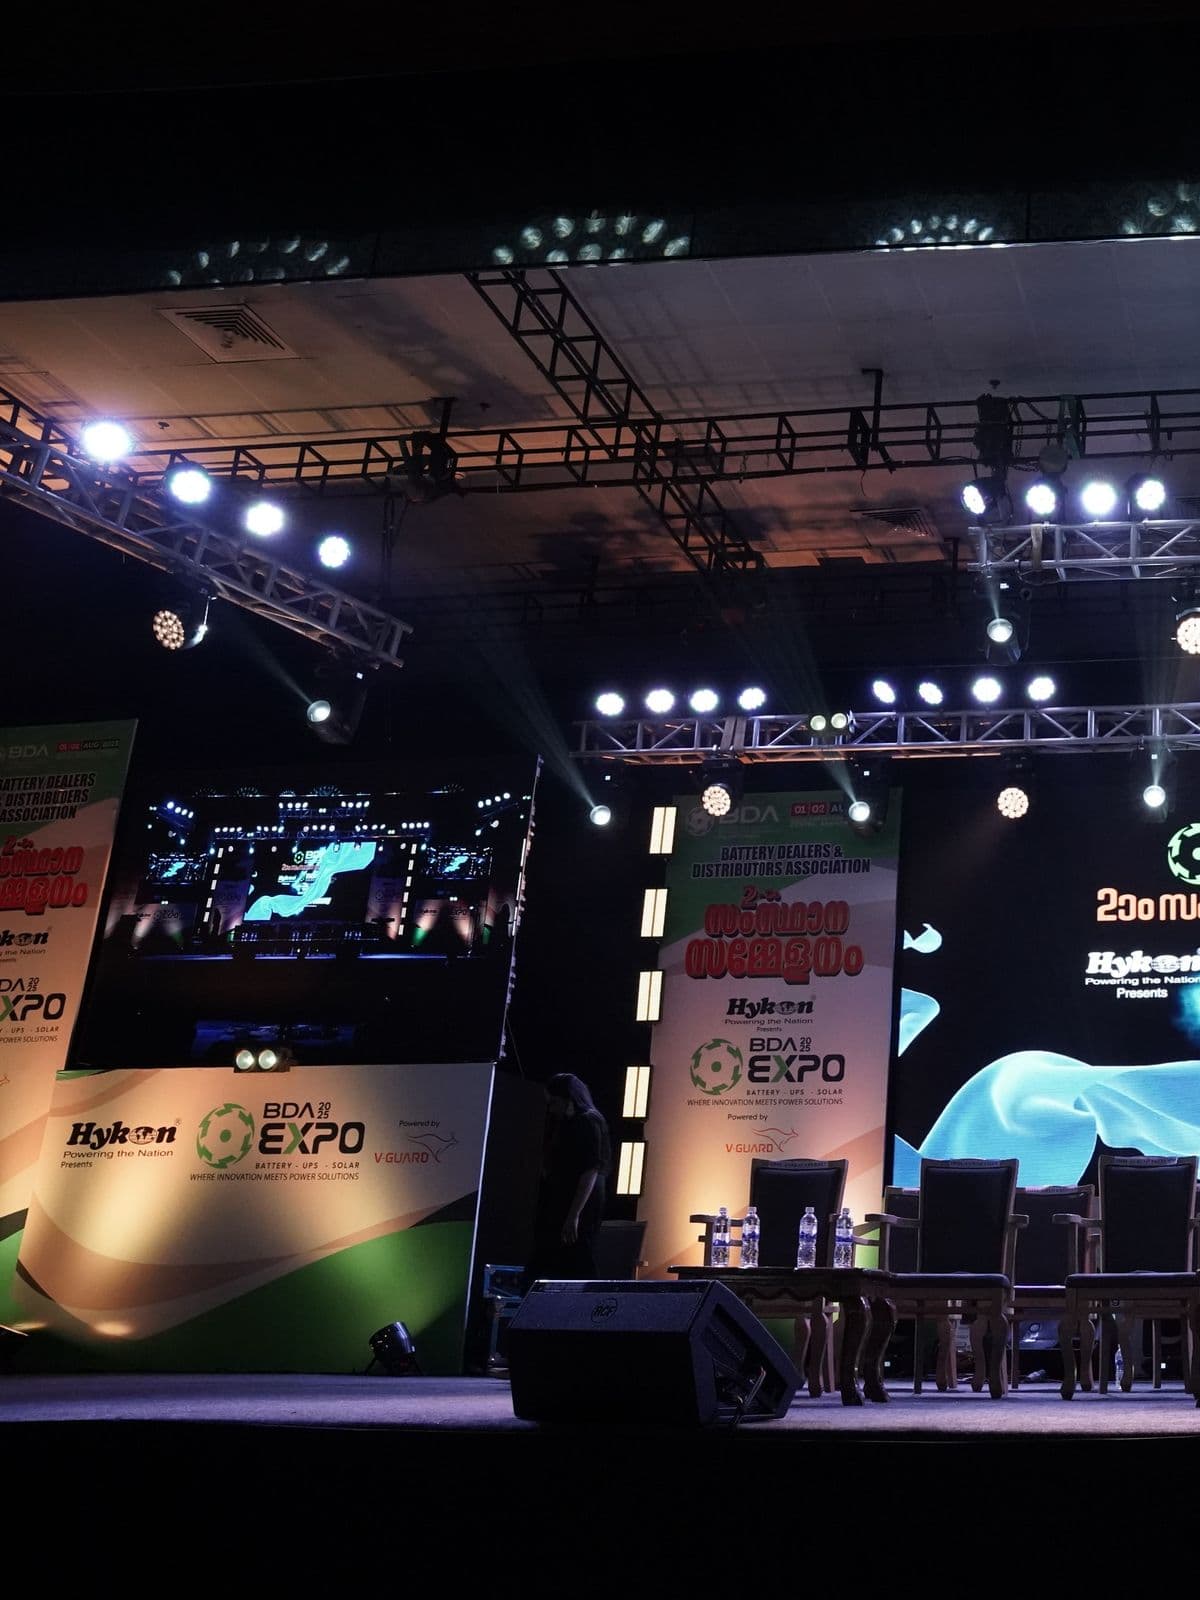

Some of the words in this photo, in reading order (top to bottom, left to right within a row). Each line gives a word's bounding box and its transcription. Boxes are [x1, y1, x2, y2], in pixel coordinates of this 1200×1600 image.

[0, 776, 46, 791] ATTERY
[46, 773, 96, 789] DEALERS
[0, 805, 77, 823] ASSOCIATION
[721, 846, 774, 861] BATTERY
[777, 844, 830, 859] DEALERS
[833, 845, 843, 857] &
[693, 861, 782, 878] DISTRIBUTORS
[785, 858, 871, 875] ASSOCIATION
[0, 930, 48, 946] kon
[0, 978, 25, 992] DA
[1085, 977, 1139, 986] Powering
[1142, 976, 1161, 984] the
[1116, 988, 1168, 999] Presents
[0, 993, 66, 1021] XPO
[726, 997, 814, 1018] Hykon
[23, 1035, 58, 1043] SOLUTIONS
[750, 1037, 797, 1052] BDA
[748, 1054, 845, 1083] EXPO
[263, 1102, 314, 1119] BDA
[760, 1113, 768, 1122] by
[399, 1120, 429, 1128] Powered
[431, 1120, 441, 1129] by
[66, 1121, 177, 1150] Hykon
[258, 1121, 366, 1155] EXPO
[63, 1150, 114, 1160] Powering
[117, 1150, 134, 1158] the
[138, 1149, 174, 1158] Nation
[60, 1161, 93, 1169] Presents
[332, 1161, 360, 1169] SOLAR
[190, 1173, 216, 1181] WHERE
[217, 1172, 262, 1181] INNOVATION
[264, 1172, 288, 1181] MEETS
[289, 1172, 315, 1181] POWER
[317, 1172, 360, 1180] SOLUTIONS
